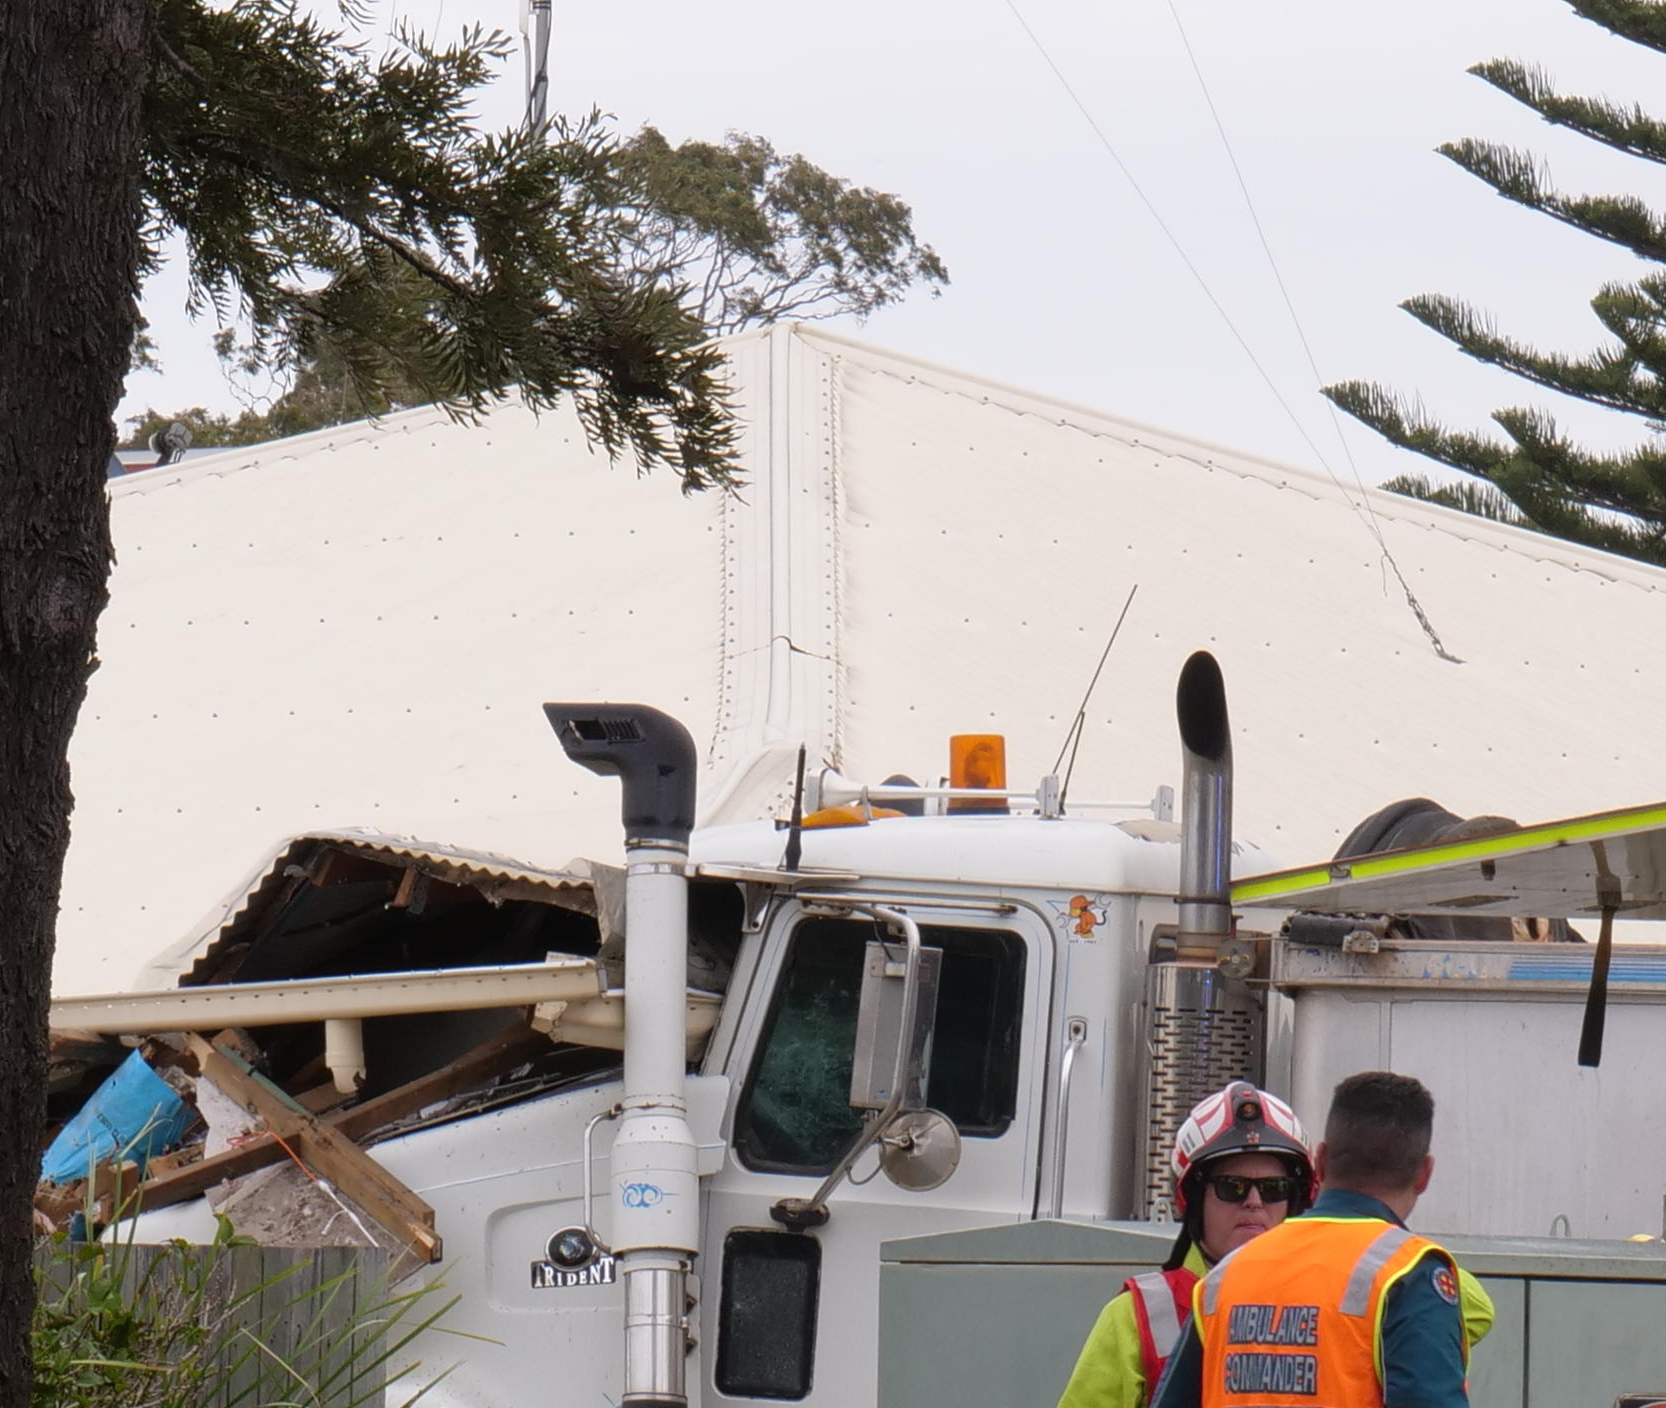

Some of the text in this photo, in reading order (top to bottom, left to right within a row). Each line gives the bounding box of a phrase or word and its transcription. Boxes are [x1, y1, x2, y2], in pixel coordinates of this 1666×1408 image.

[533, 1257, 614, 1288] TRIDENT
[1228, 1305, 1319, 1346] AMBULANCE
[1225, 1353, 1318, 1395] COMMANDER
